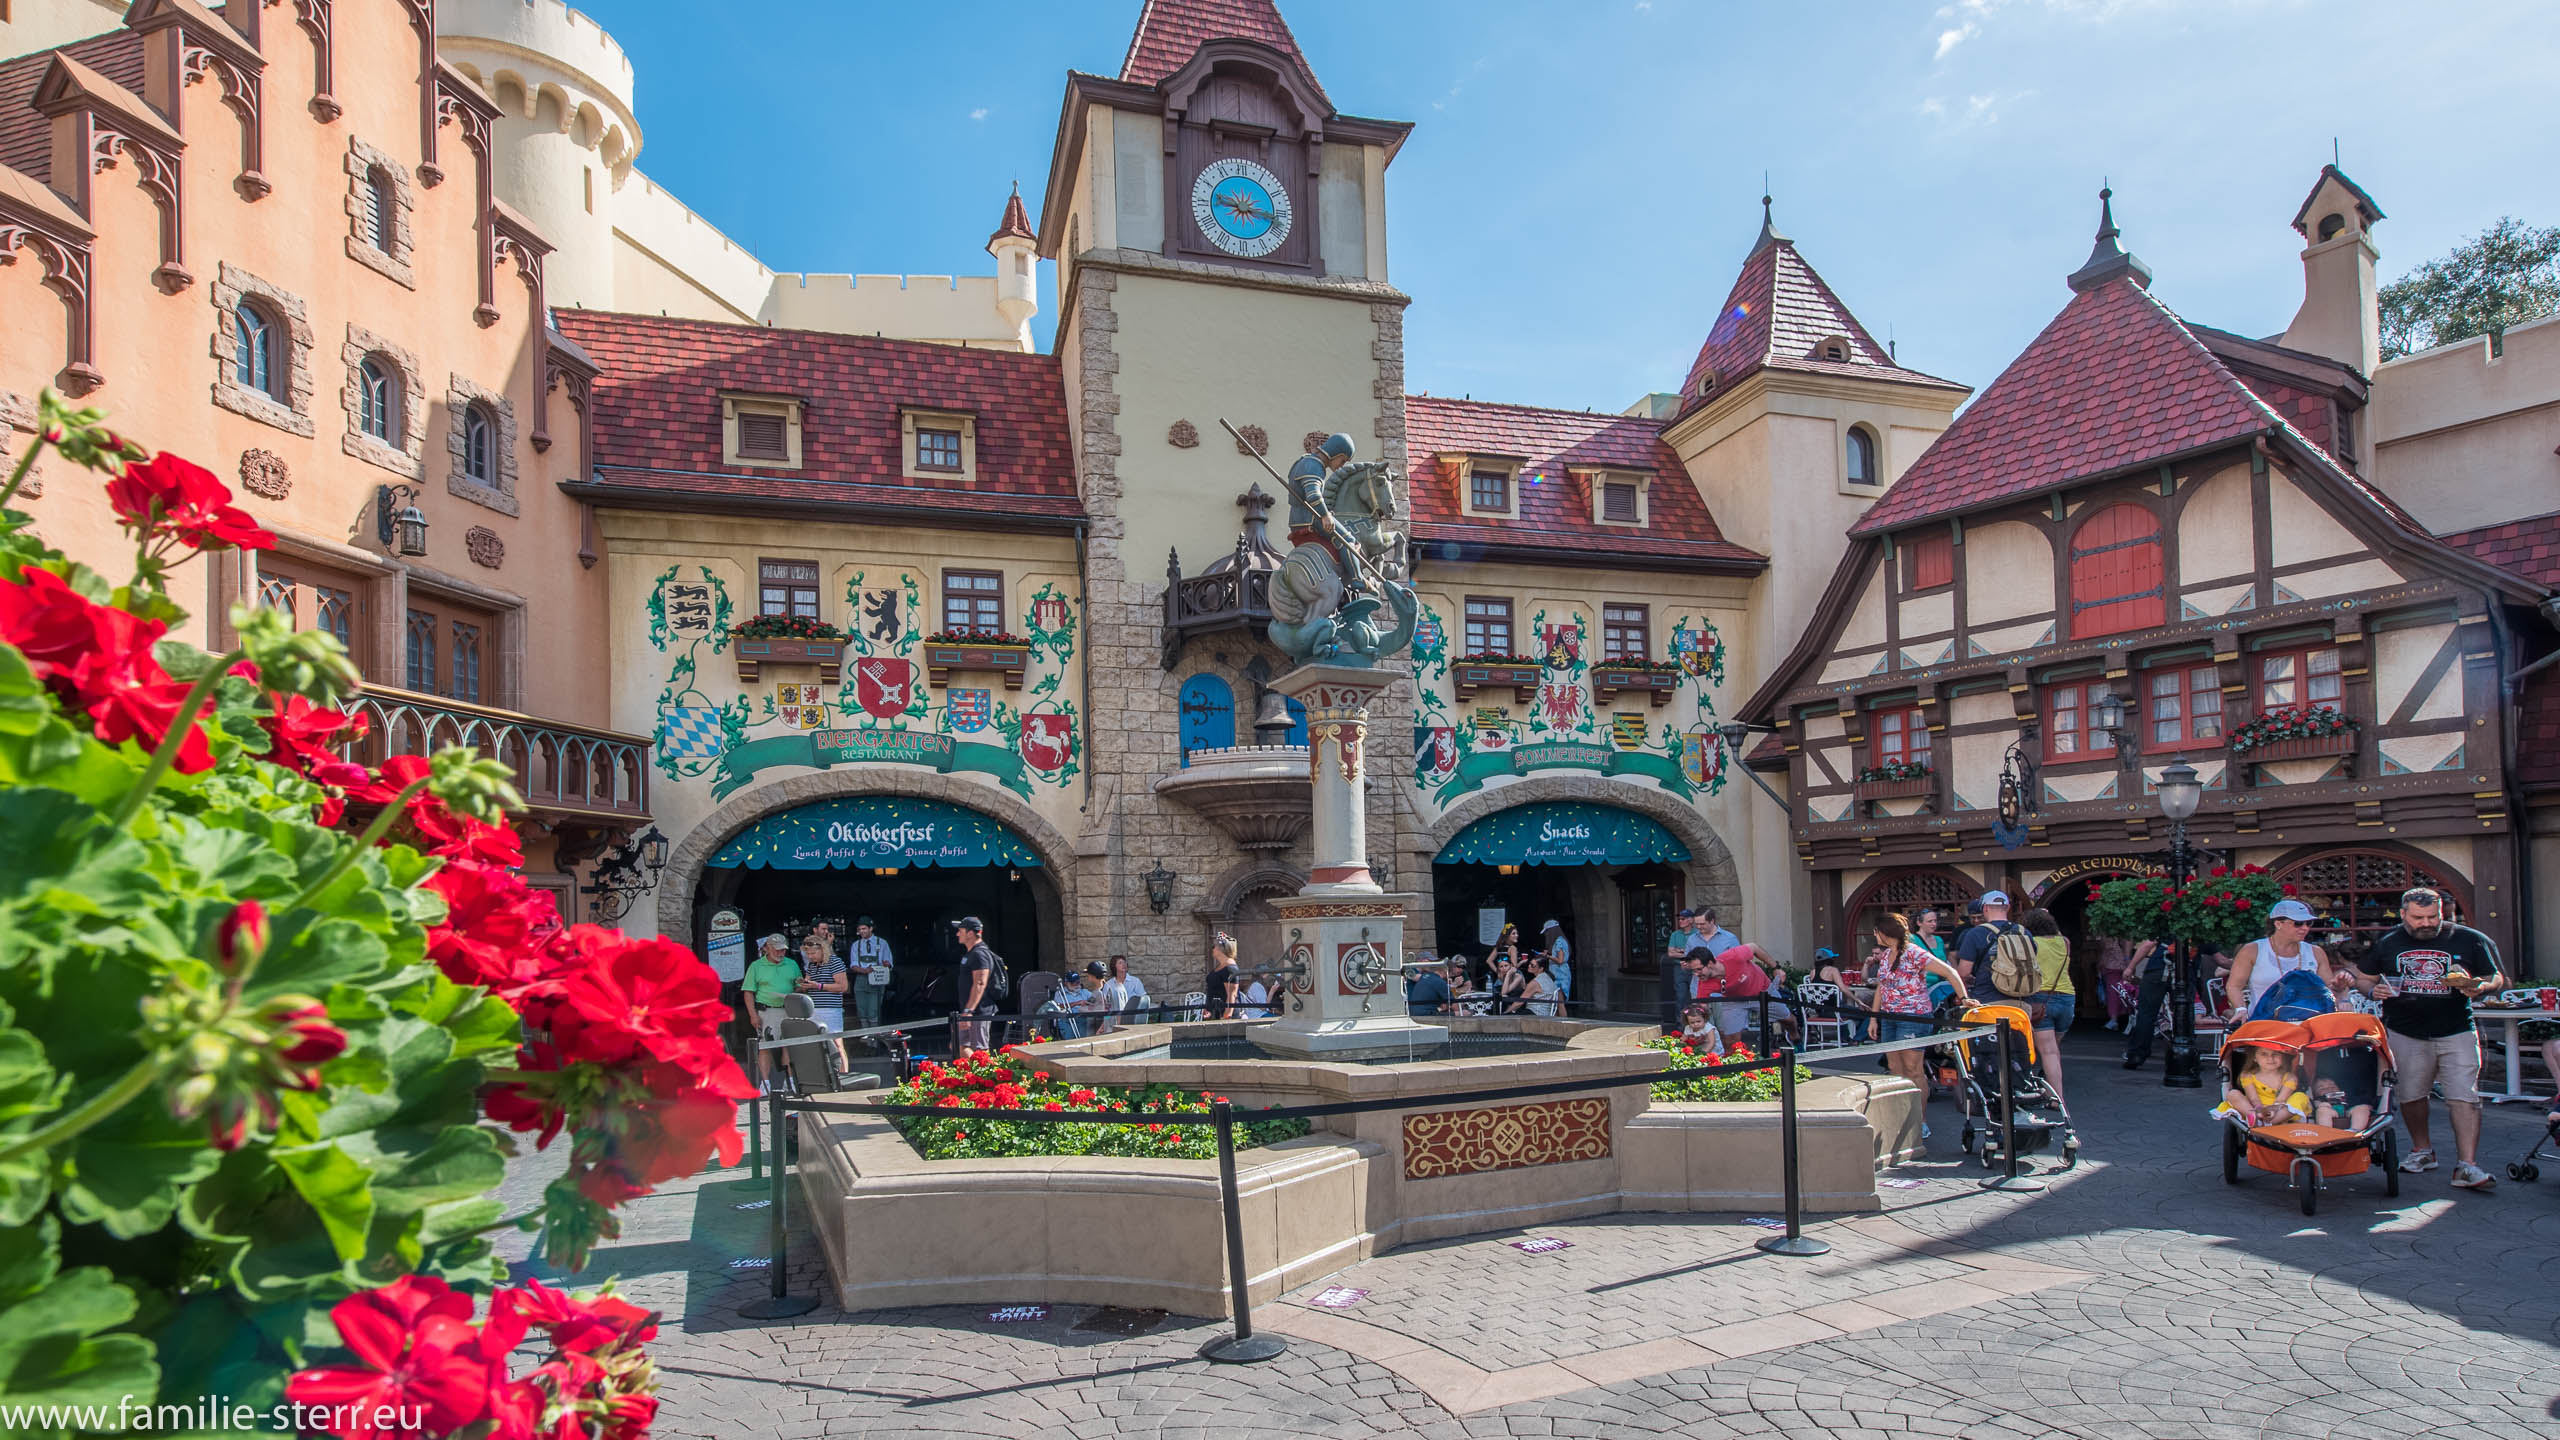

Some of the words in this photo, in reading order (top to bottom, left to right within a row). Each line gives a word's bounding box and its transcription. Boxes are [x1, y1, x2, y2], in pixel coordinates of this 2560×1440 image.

[817, 730, 952, 755] BIERGARTEN
[841, 749, 923, 761] RESTAURANT
[1515, 747, 1613, 769] SOMMERFEST
[828, 821, 935, 854] Oktoberfest
[1540, 819, 1590, 842] Snacks
[792, 846, 821, 860] Lunch
[825, 846, 855, 859] Buffet
[905, 847, 937, 857] Dinner
[939, 845, 968, 857] Buffet
[2049, 863, 2080, 883] DER
[990, 1311, 1047, 1321] PAINT
[1001, 1306, 1040, 1314] WET
